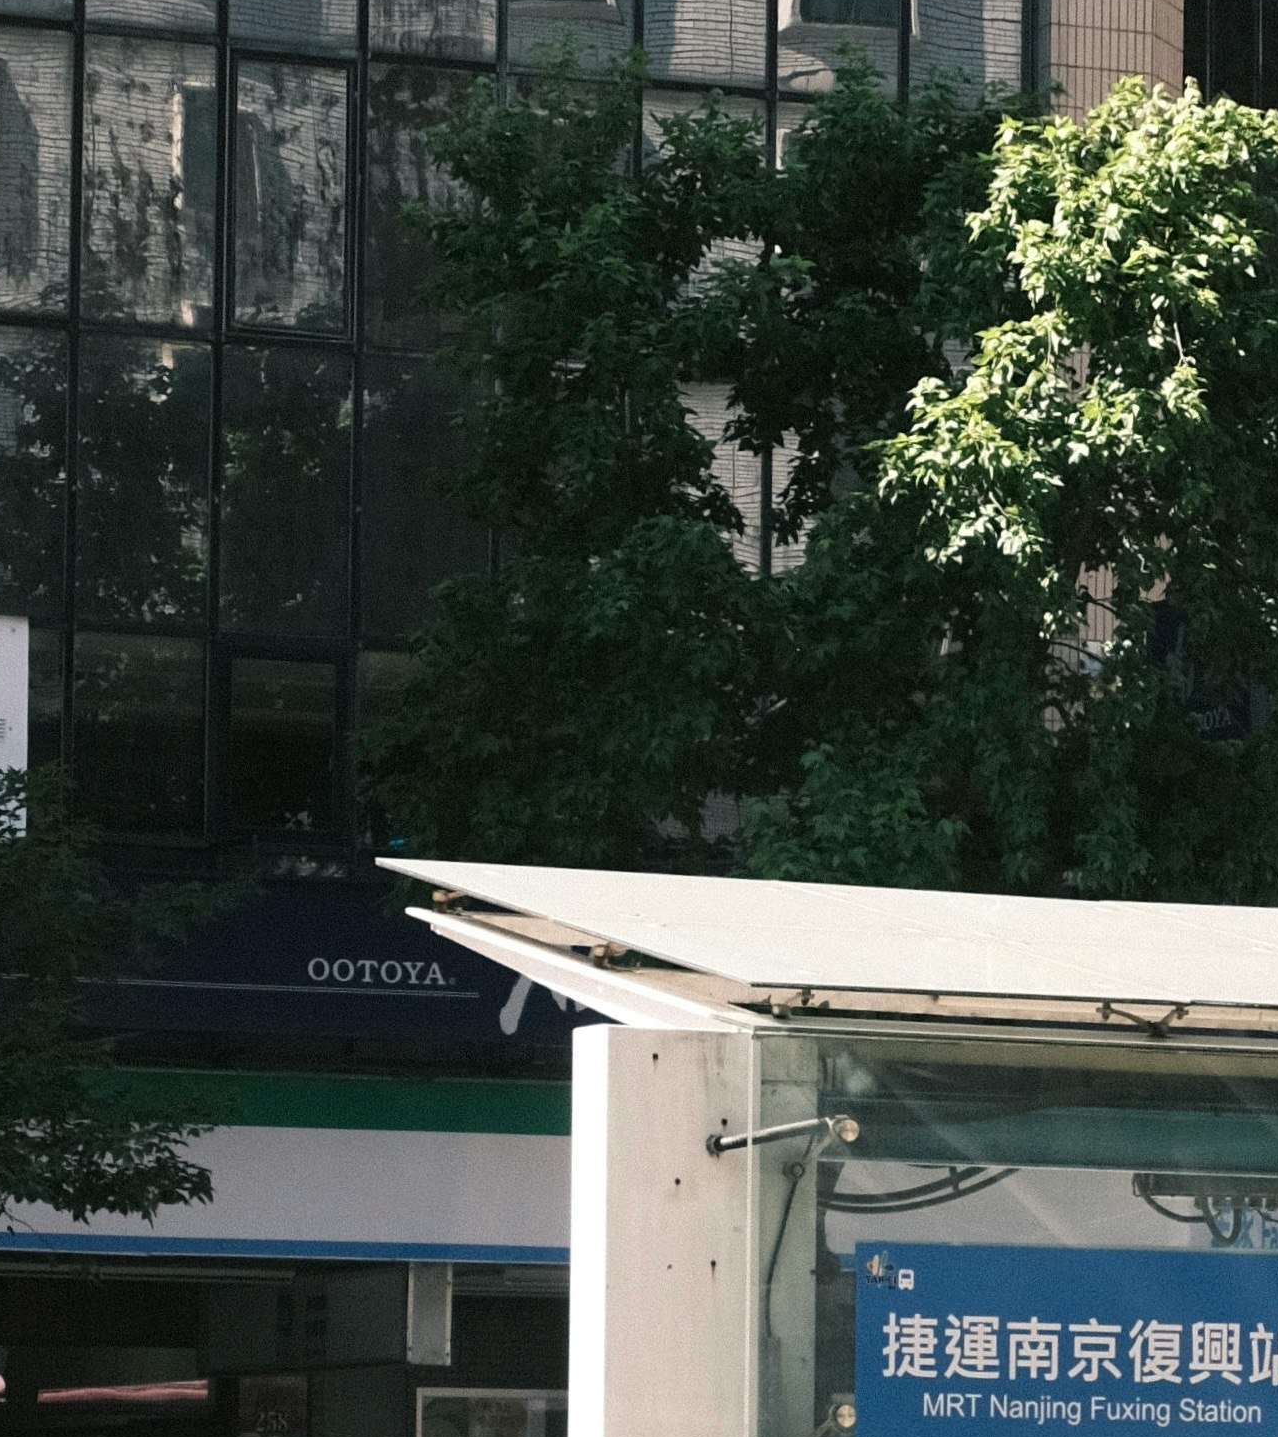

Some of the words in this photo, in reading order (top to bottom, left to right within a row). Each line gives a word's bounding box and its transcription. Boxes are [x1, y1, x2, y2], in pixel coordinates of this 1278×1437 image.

[306, 956, 447, 986] OOTOYA
[922, 1393, 981, 1421] MRT
[988, 1394, 1083, 1427] Nanjing
[1090, 1396, 1172, 1429] Fuxing
[1178, 1398, 1263, 1425] Station
